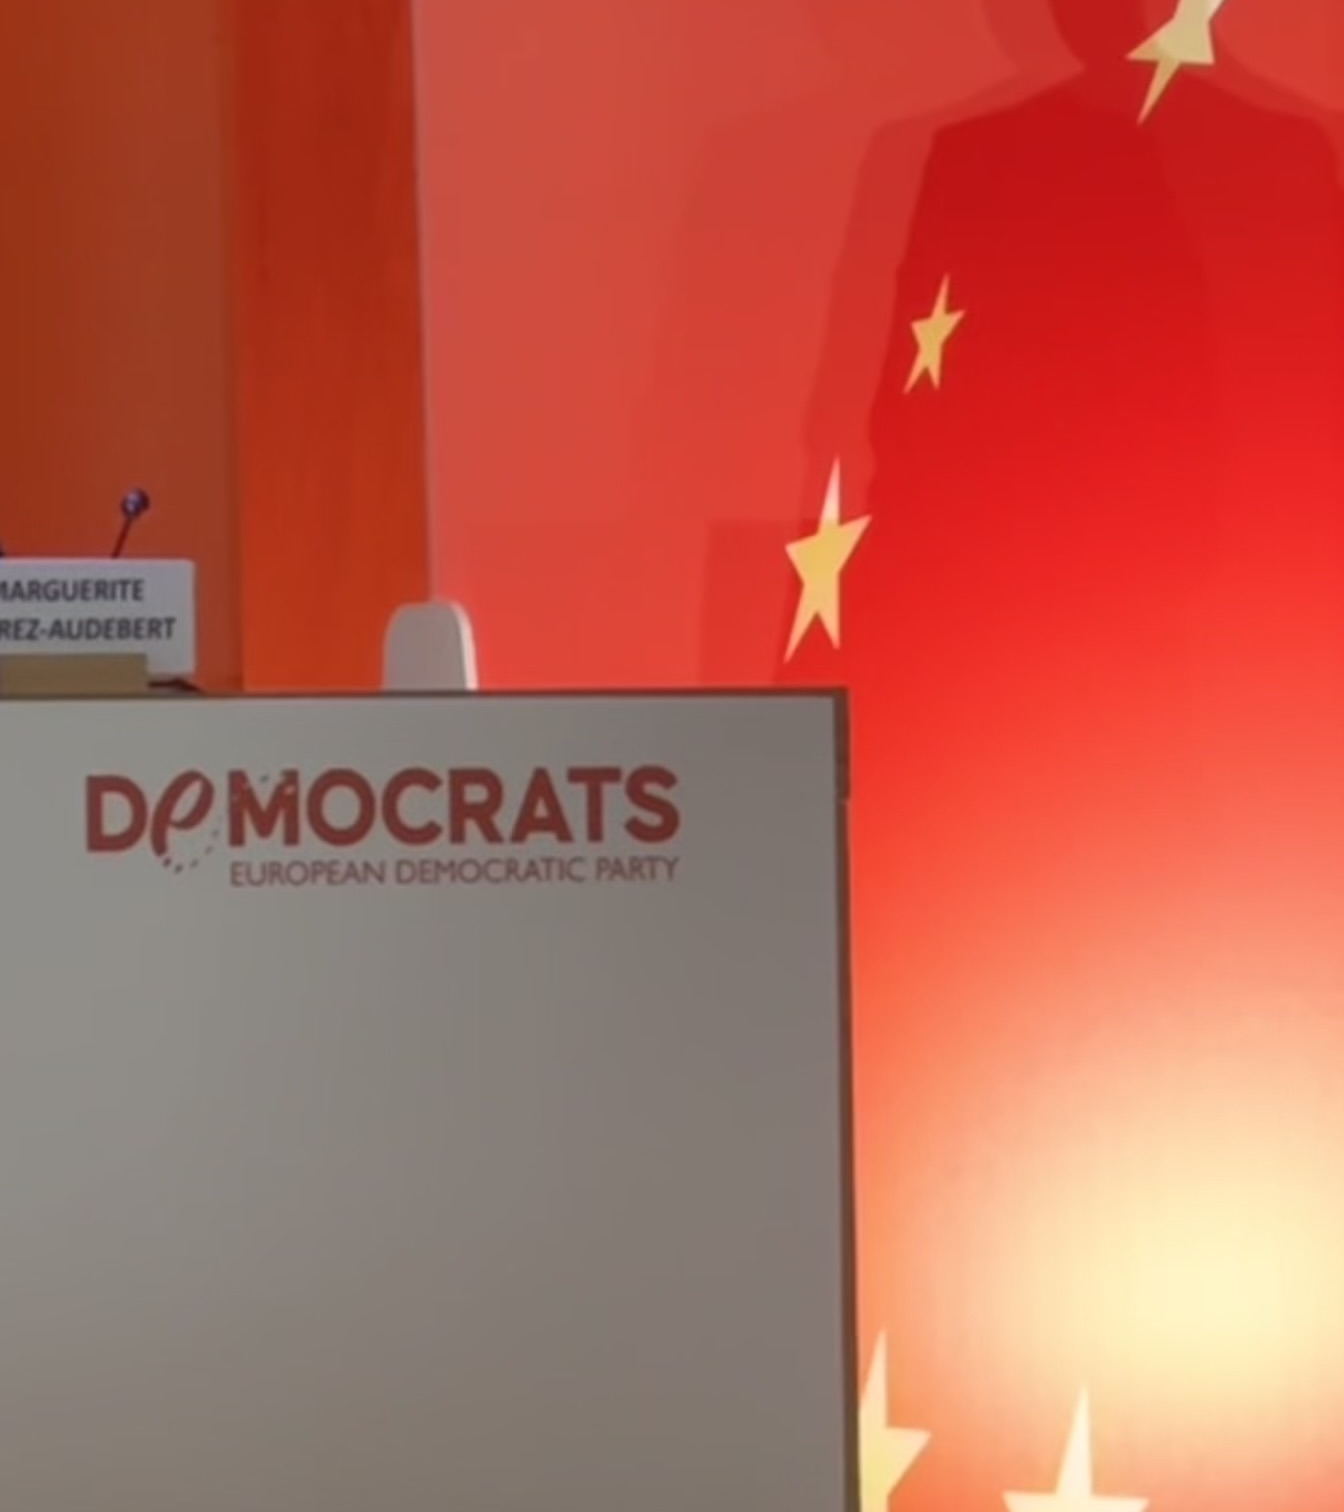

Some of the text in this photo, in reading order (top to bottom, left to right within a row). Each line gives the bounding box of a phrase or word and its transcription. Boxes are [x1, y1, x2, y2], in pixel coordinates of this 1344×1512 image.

[0, 617, 177, 641] REZ-AUDEBERT
[230, 855, 680, 887] EUROPEAN DEMOCRATIC PARTY
